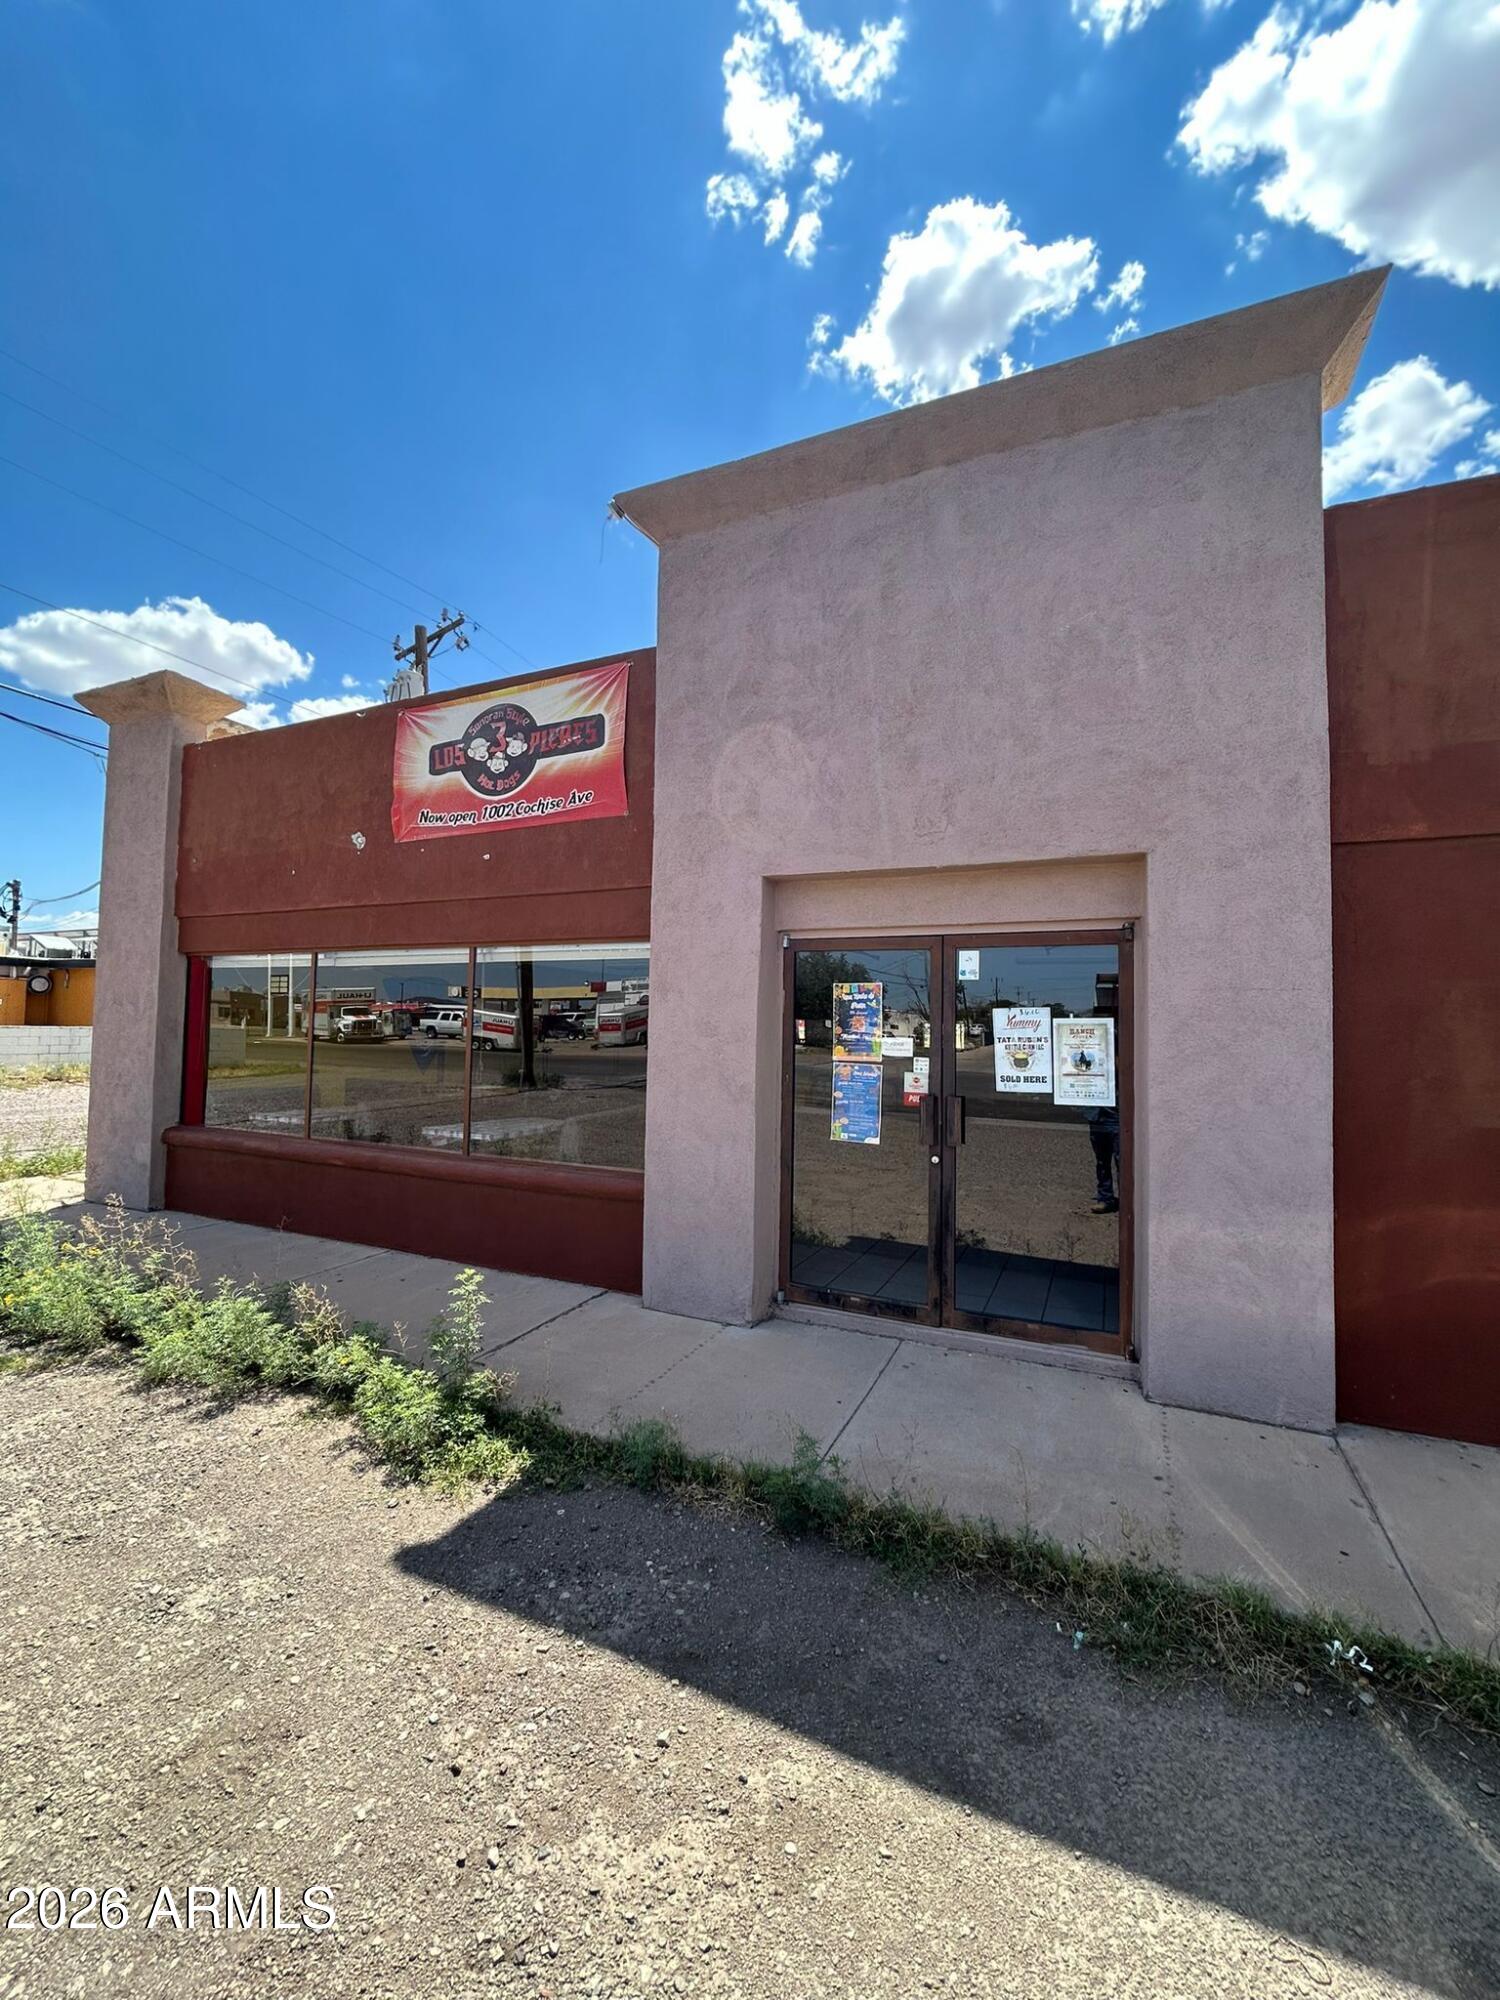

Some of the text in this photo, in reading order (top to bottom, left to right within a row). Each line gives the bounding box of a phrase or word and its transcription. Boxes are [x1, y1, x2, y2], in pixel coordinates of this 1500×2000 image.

[434, 743, 466, 770] LOS
[489, 721, 507, 752] 3
[418, 788, 594, 826] Now open 1002 Cochise Ave
[1006, 1013, 1042, 1033] Yummy
[1000, 1075, 1048, 1084] SOLD HERE
